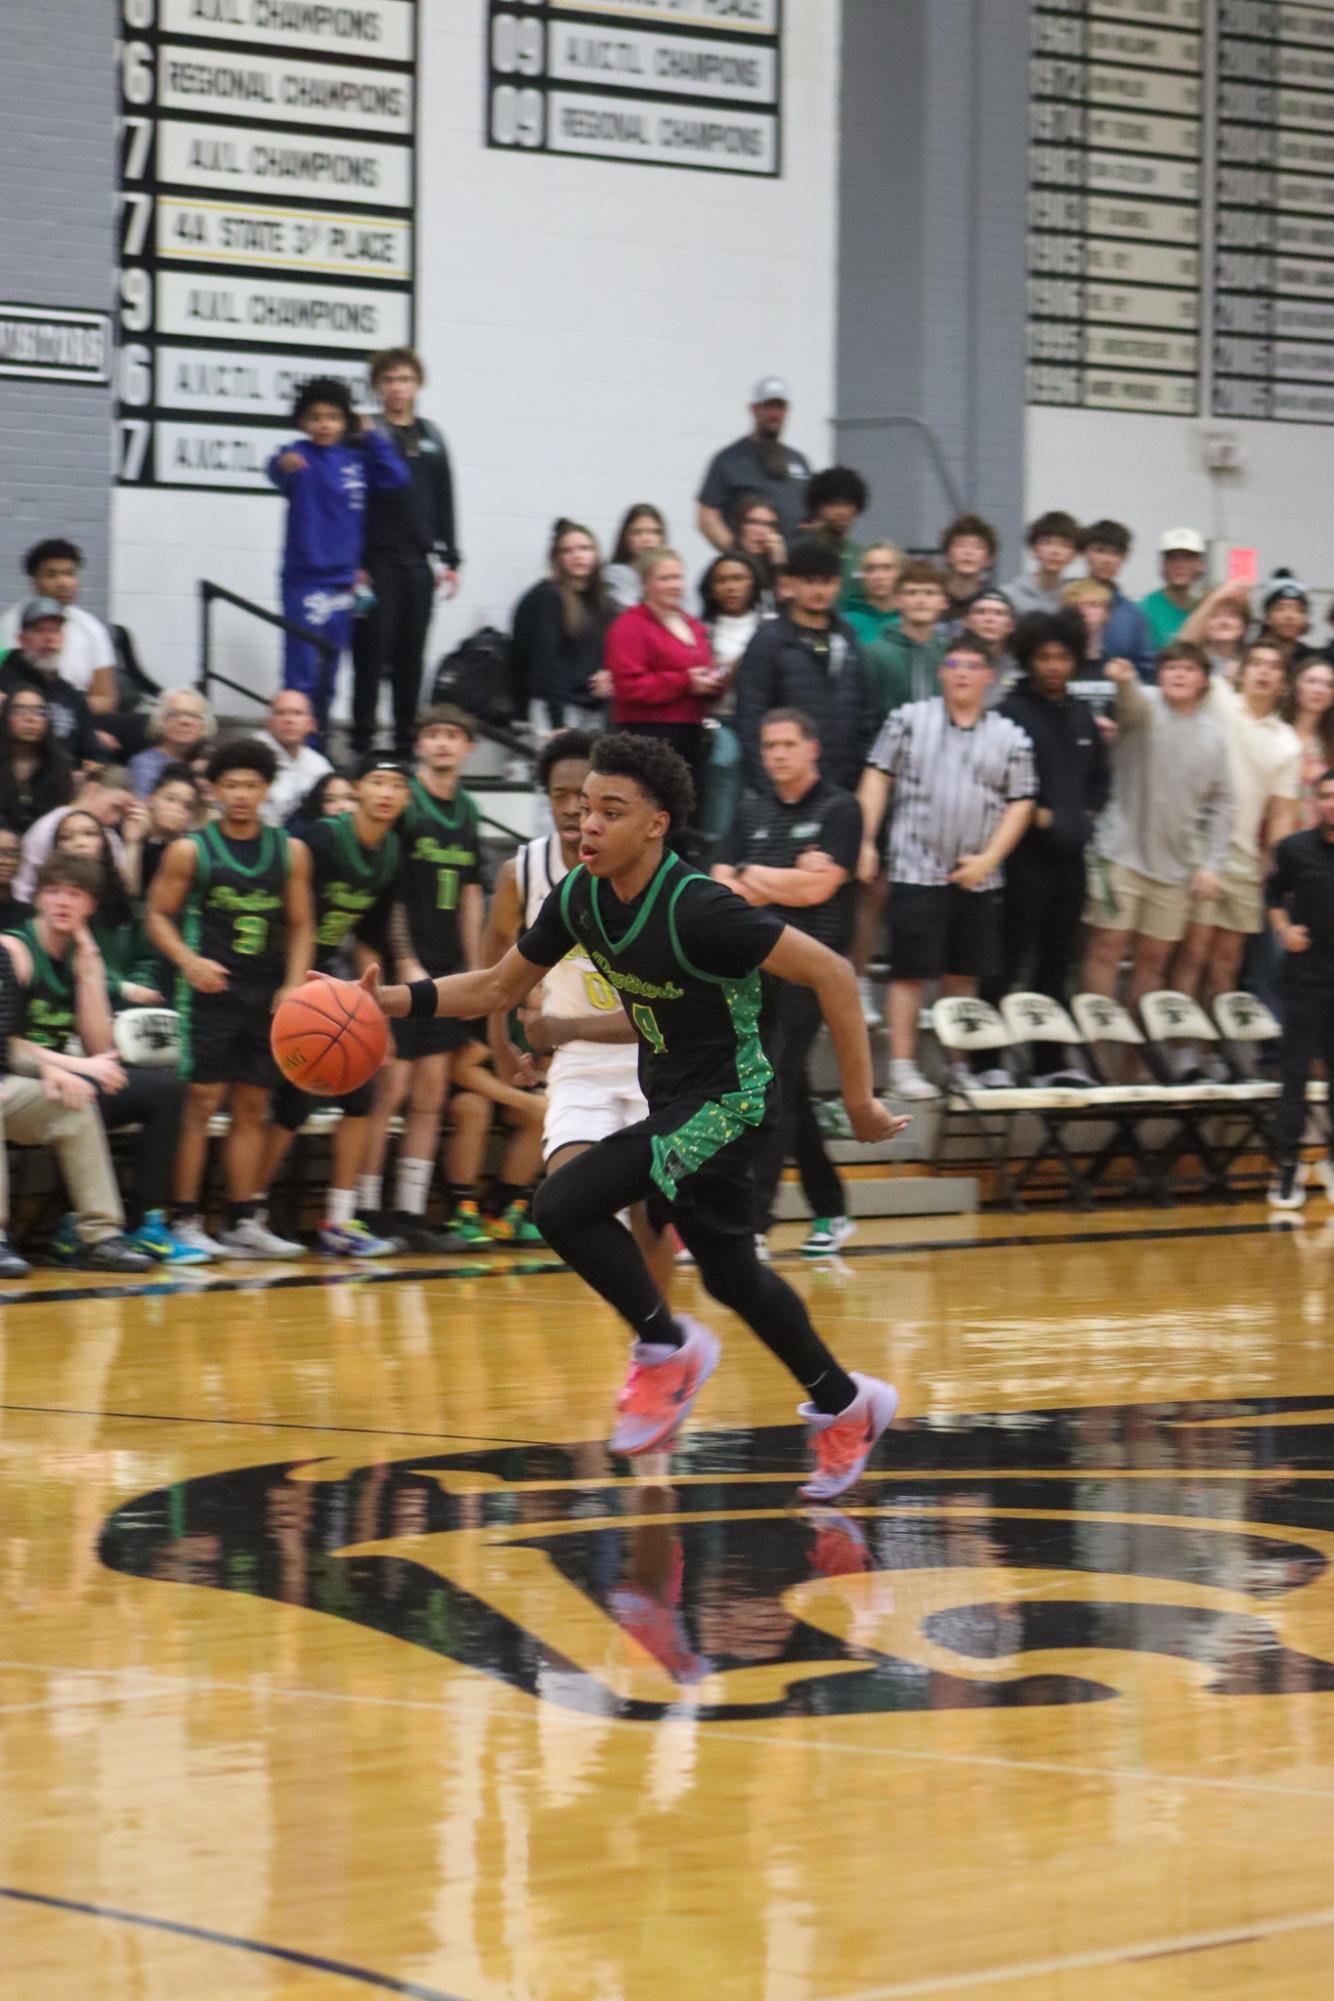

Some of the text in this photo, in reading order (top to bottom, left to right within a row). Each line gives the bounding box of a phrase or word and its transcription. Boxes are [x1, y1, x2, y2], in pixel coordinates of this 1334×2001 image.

[253, 0, 382, 42] CHAMPIONS
[169, 60, 275, 104] REGIONAL
[280, 74, 402, 117] CHAMPIONS
[655, 47, 762, 88] CHAMPIONS
[561, 107, 650, 145] REGIONAL
[658, 117, 763, 156] CHAMPIONS
[252, 144, 381, 188] CHAMPIONS
[219, 217, 285, 253] STATE
[328, 227, 397, 263] PLACE
[249, 295, 379, 335] CHAMPIONS
[232, 915, 269, 955] 3
